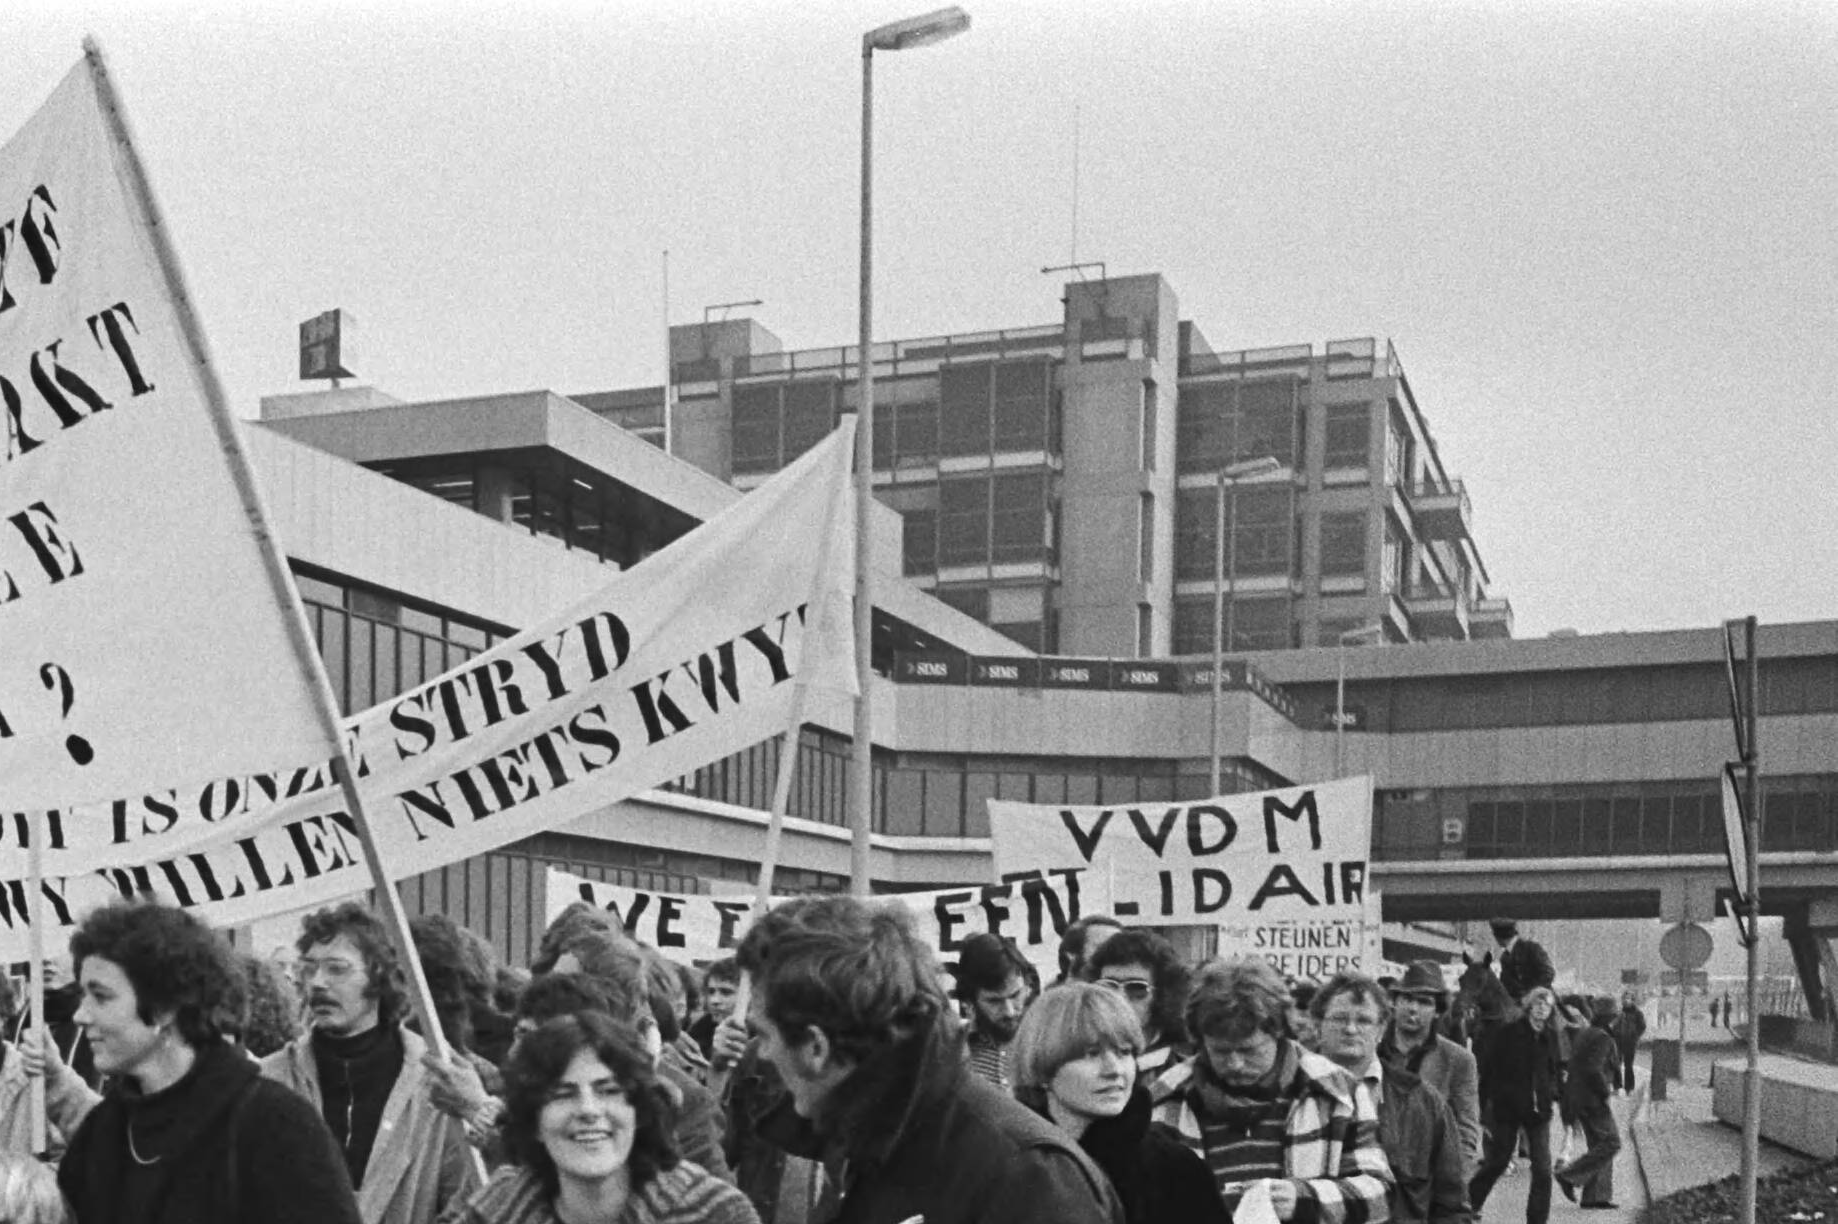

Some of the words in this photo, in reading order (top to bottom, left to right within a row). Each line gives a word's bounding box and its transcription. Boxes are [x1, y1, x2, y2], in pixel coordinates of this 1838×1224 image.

[39, 661, 95, 766] ?
[112, 789, 178, 844] IS
[388, 611, 631, 762] STRYD
[396, 703, 621, 842] NIETS
[630, 602, 809, 746] KWY
[1254, 925, 1351, 949] STEUNEN
